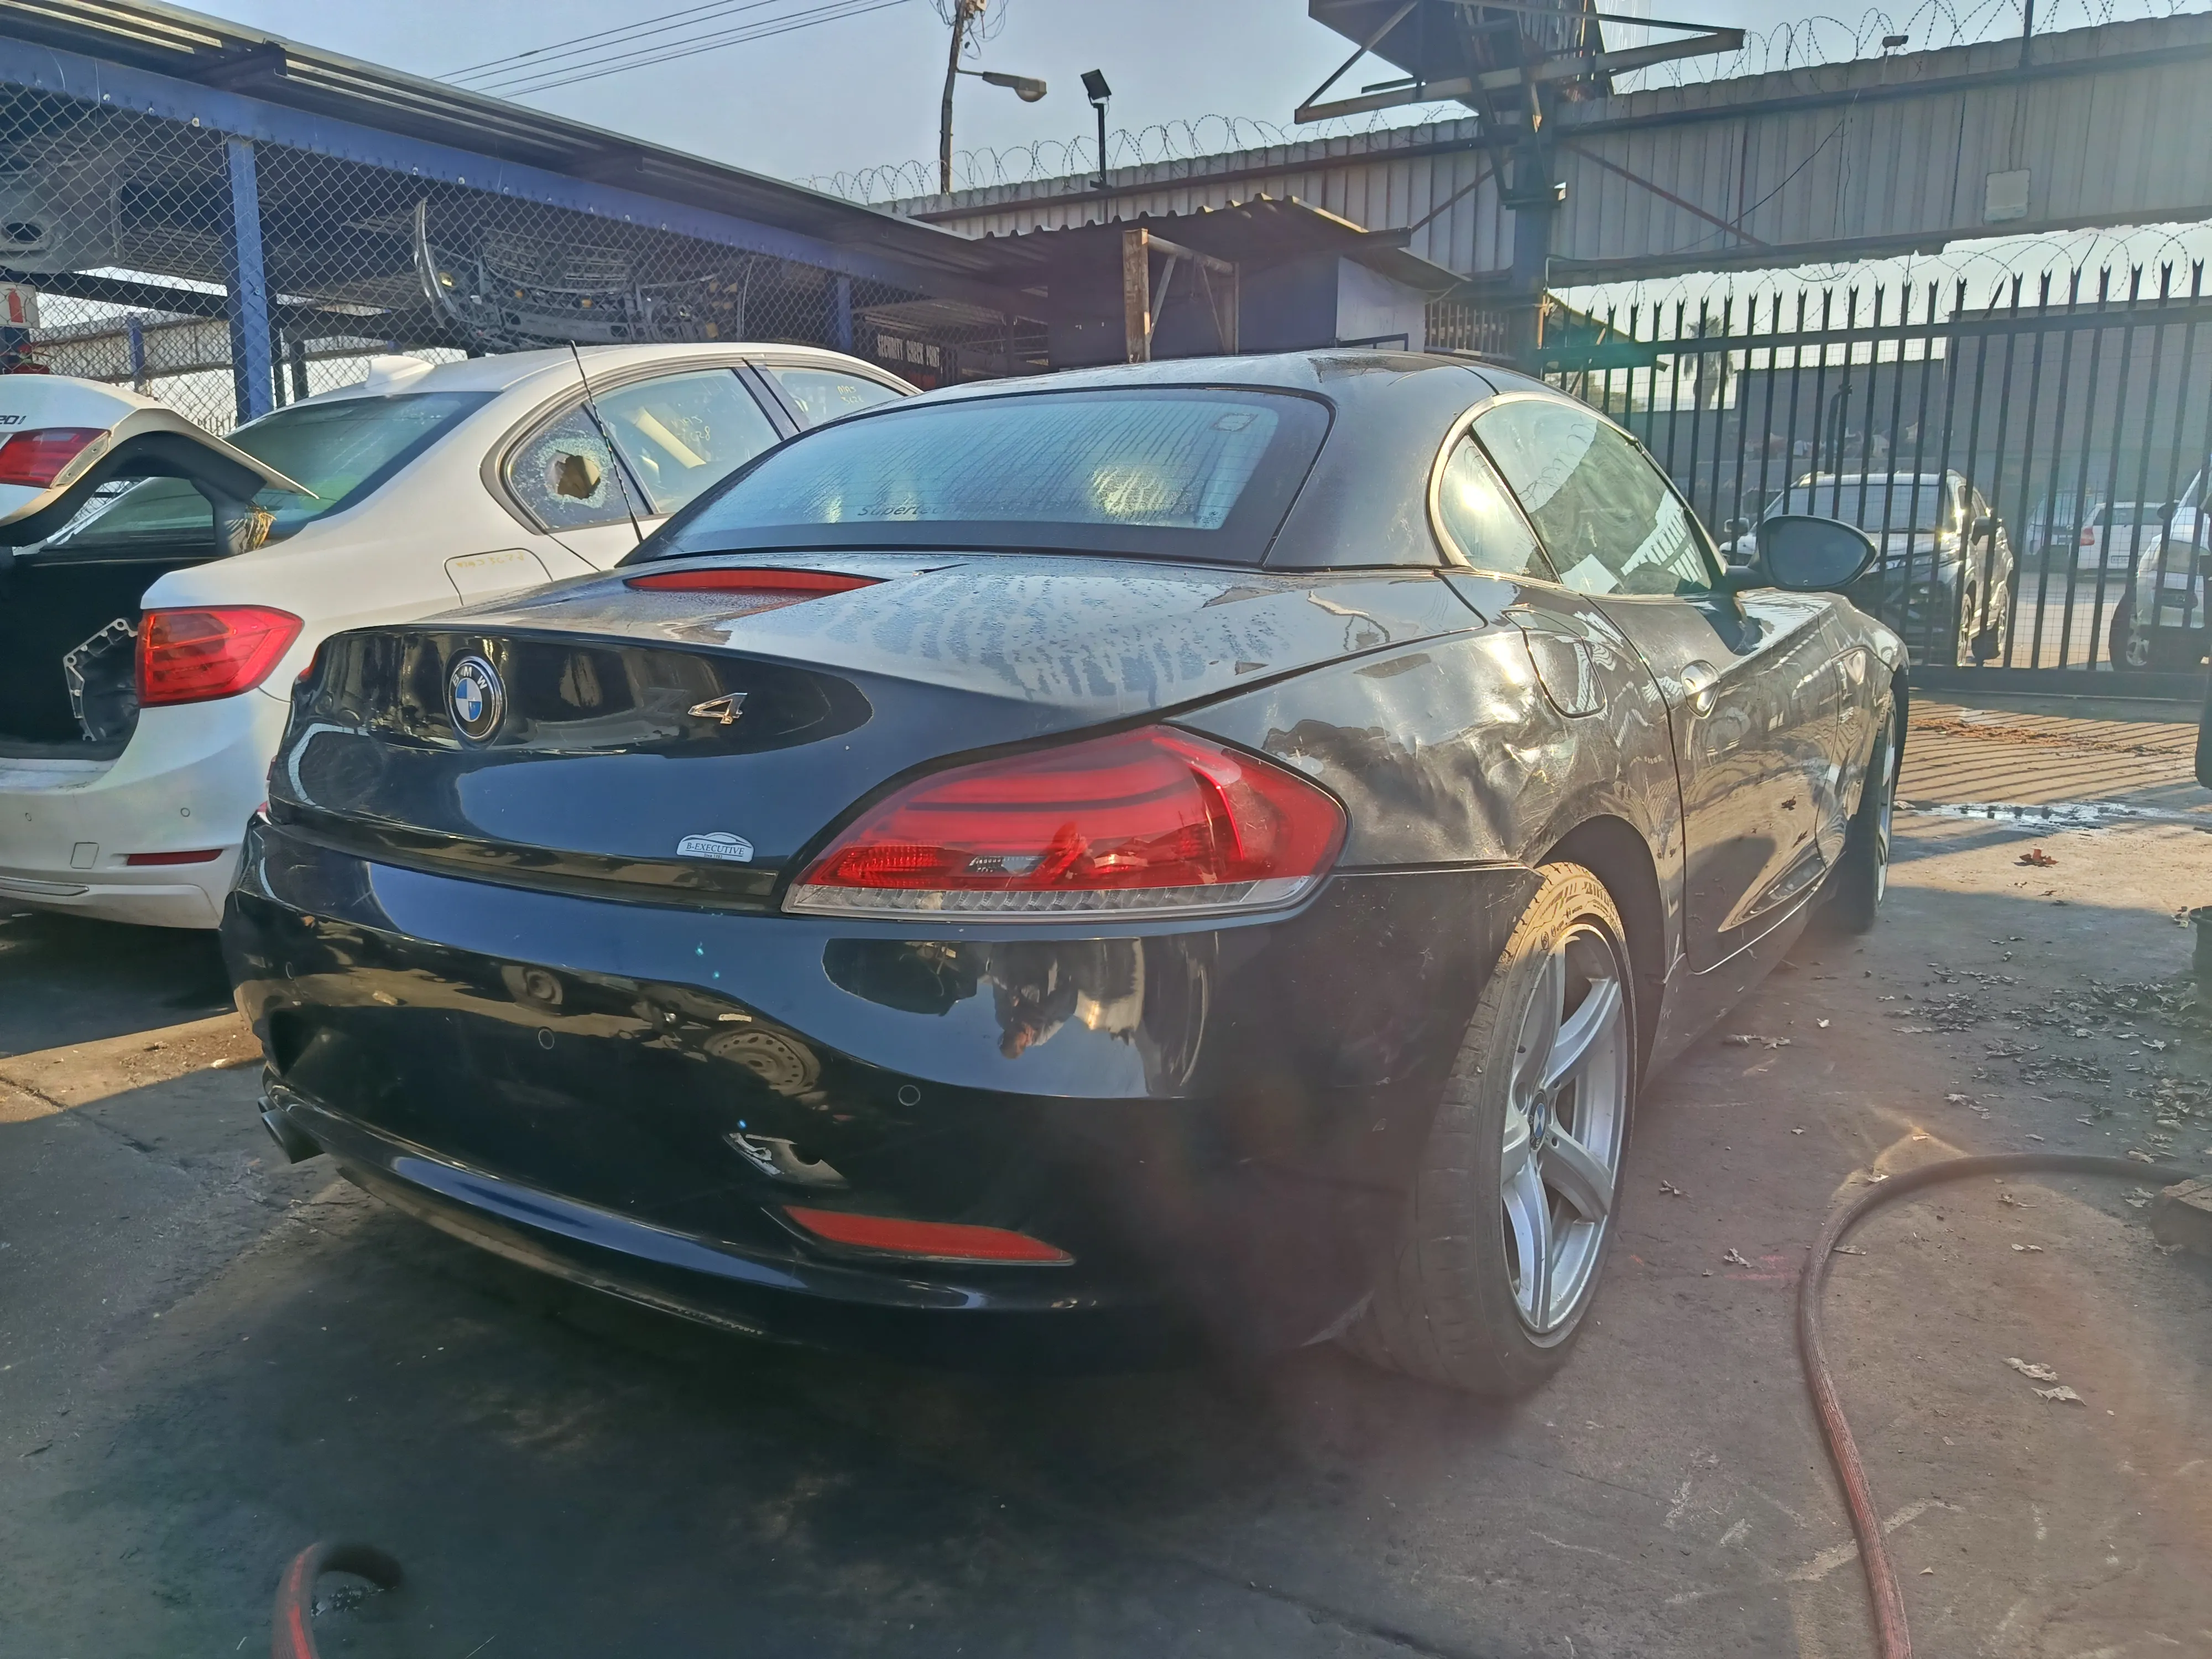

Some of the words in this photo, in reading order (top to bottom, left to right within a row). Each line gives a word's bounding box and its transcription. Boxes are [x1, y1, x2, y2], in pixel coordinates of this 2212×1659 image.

[877, 334, 903, 361] SECURITY
[452, 666, 488, 690] BMW
[686, 842, 745, 855] B-EXECUTIVE
